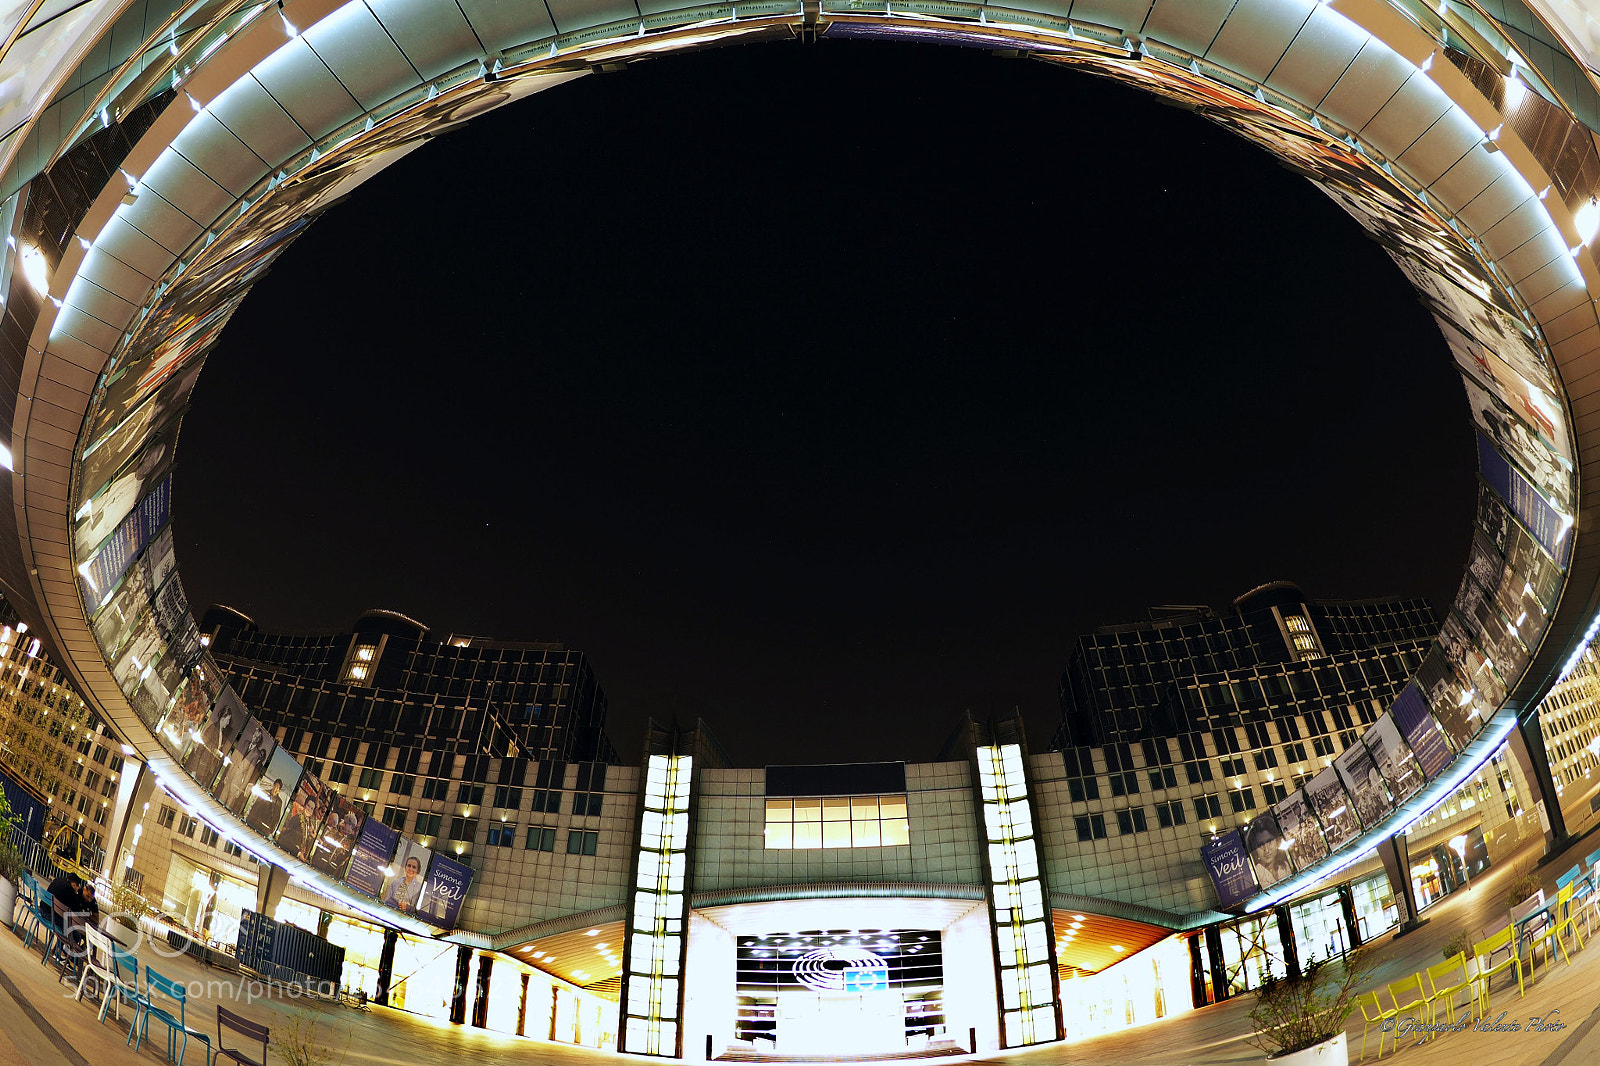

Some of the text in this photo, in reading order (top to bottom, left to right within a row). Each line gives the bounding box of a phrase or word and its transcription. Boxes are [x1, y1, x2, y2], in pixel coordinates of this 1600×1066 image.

[1210, 847, 1239, 865] Simone
[1213, 853, 1245, 878] Veil
[434, 870, 464, 886] Simone
[433, 877, 463, 901] Veil
